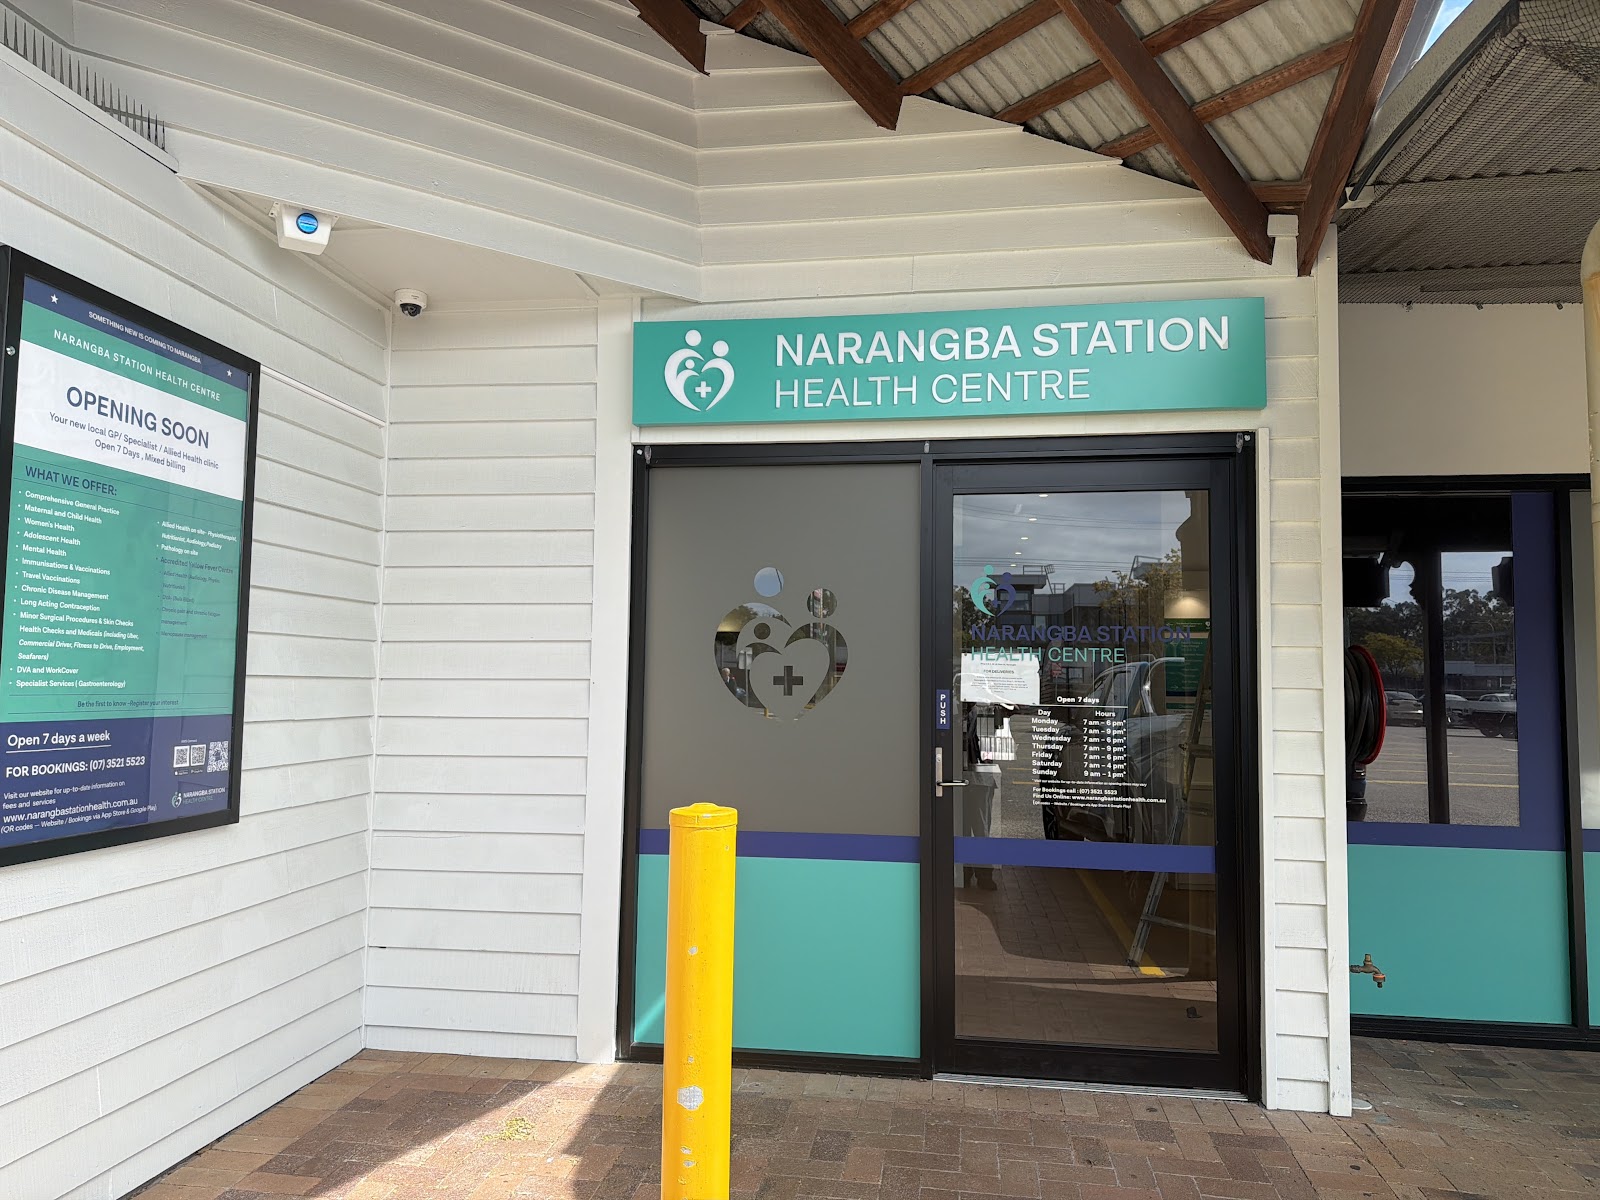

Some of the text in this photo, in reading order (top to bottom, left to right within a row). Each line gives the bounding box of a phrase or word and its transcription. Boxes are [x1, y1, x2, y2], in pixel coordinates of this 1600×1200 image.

[88, 311, 124, 331] SOMETHING
[124, 326, 138, 337] NEW
[138, 332, 144, 340] IS
[144, 334, 166, 349] COMING
[167, 344, 173, 352] TO
[774, 315, 1230, 367] NARANGBA STATION
[54, 329, 221, 401] NARANGBA STATION HEALTH CENTRE
[774, 367, 1091, 409] HEALTH CENTRE
[66, 386, 209, 449] OPENING SOON
[49, 411, 68, 425] Your
[69, 420, 86, 430] new
[87, 422, 107, 436] local
[123, 434, 160, 452] Specialist
[163, 446, 182, 458] Allied
[182, 451, 203, 465] Health
[203, 458, 219, 470] clinic
[94, 438, 186, 473] Open 7 Days Mixed billing
[25, 465, 117, 496] WHAT WE OFFER:
[25, 490, 120, 516] Comprehensive General Practice
[24, 503, 102, 525] Maternal and Child Health
[24, 516, 75, 532] Women's Health
[23, 530, 81, 546] Adolescent Health
[22, 543, 67, 557] Mental Health
[22, 557, 111, 576] Immunisations & Vaccinations
[21, 570, 81, 585] Travel Vaccinations
[21, 584, 109, 600] Chronic Disease Management
[20, 598, 100, 612] Long Acting Contraception
[20, 611, 134, 627] Minor Surgical Procedures Skin Checks
[19, 625, 102, 637] Health Checks and Medicals
[971, 624, 1191, 643] NARANGBA STATION
[18, 653, 49, 661] Seafarers)
[971, 646, 1125, 663] HEALTH CENTRE
[16, 666, 79, 674] DVA and WorkCover
[15, 680, 48, 689] Specialist
[149, 700, 161, 708] your
[1056, 695, 1076, 704] Open
[1083, 696, 1100, 704] days
[1031, 717, 1059, 725] Monday
[1037, 709, 1052, 717] Day
[1031, 725, 1060, 734] Tuesday
[7, 730, 111, 749] Open 7 days a week
[1031, 734, 1072, 743] Wednesday
[1031, 742, 1064, 751] Thursday
[1031, 751, 1053, 759] Friday
[5, 755, 146, 778] FOR BOOKINGS: (07) 3521 5523
[1031, 759, 1063, 768] Saturday
[1032, 768, 1058, 777] Sunday
[3, 792, 18, 800] Visit
[29, 789, 54, 797] website
[62, 785, 91, 794] up-to-date
[90, 781, 118, 790] information
[3, 798, 138, 823] www.narangbastationhealth.com.au
[17, 800, 31, 808] and
[32, 798, 57, 807] services
